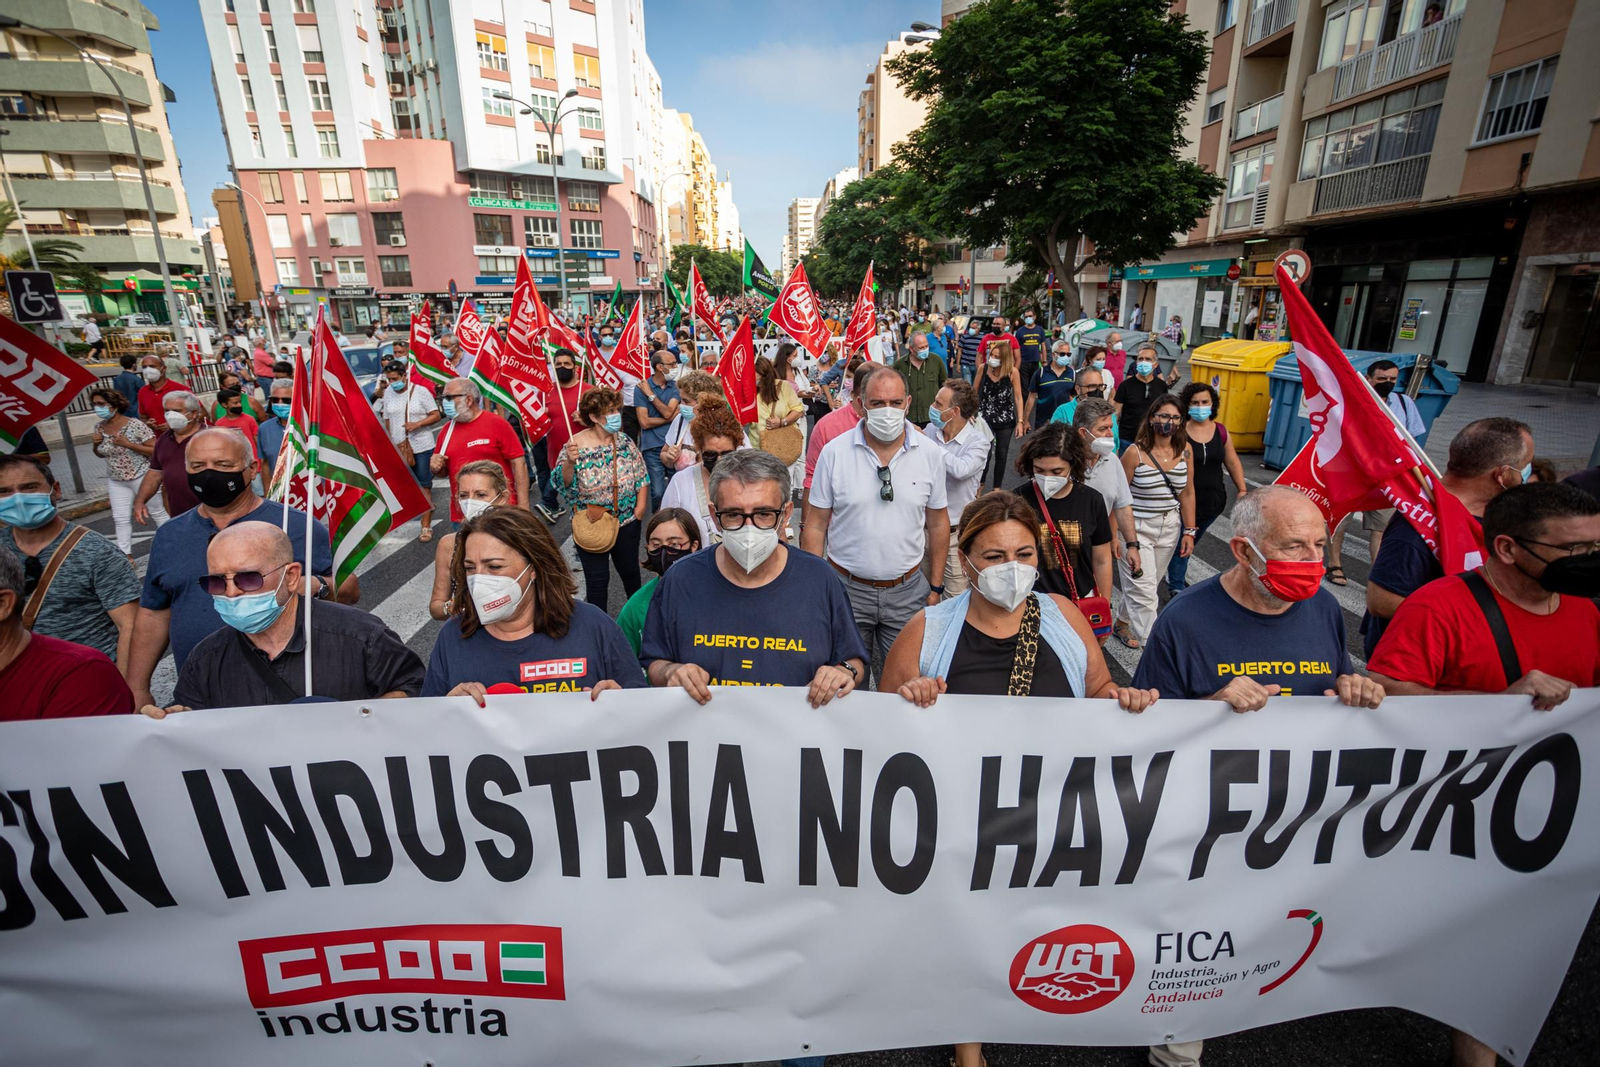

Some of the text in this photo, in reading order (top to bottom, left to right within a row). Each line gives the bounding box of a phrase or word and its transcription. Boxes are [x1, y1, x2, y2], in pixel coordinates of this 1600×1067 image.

[789, 286, 818, 325] UGT
[694, 634, 807, 652] PUERTO REAL
[524, 662, 570, 677] CCOO
[1217, 661, 1332, 676] PUERTO REAL
[533, 680, 582, 693] REAL
[182, 741, 765, 899] INDUSTRIA
[799, 747, 938, 894] NO
[970, 750, 1175, 891] HAY
[1188, 732, 1582, 881] FUTURO
[1024, 941, 1121, 977] UGT
[1154, 931, 1235, 964] FICA
[262, 940, 488, 995] CCOO
[1148, 958, 1281, 991] Construcción y Agro
[1151, 966, 1218, 980] Industria,
[1144, 987, 1224, 1004] Andalucía
[256, 998, 509, 1038] industria
[1141, 1003, 1174, 1014] Cádiz
